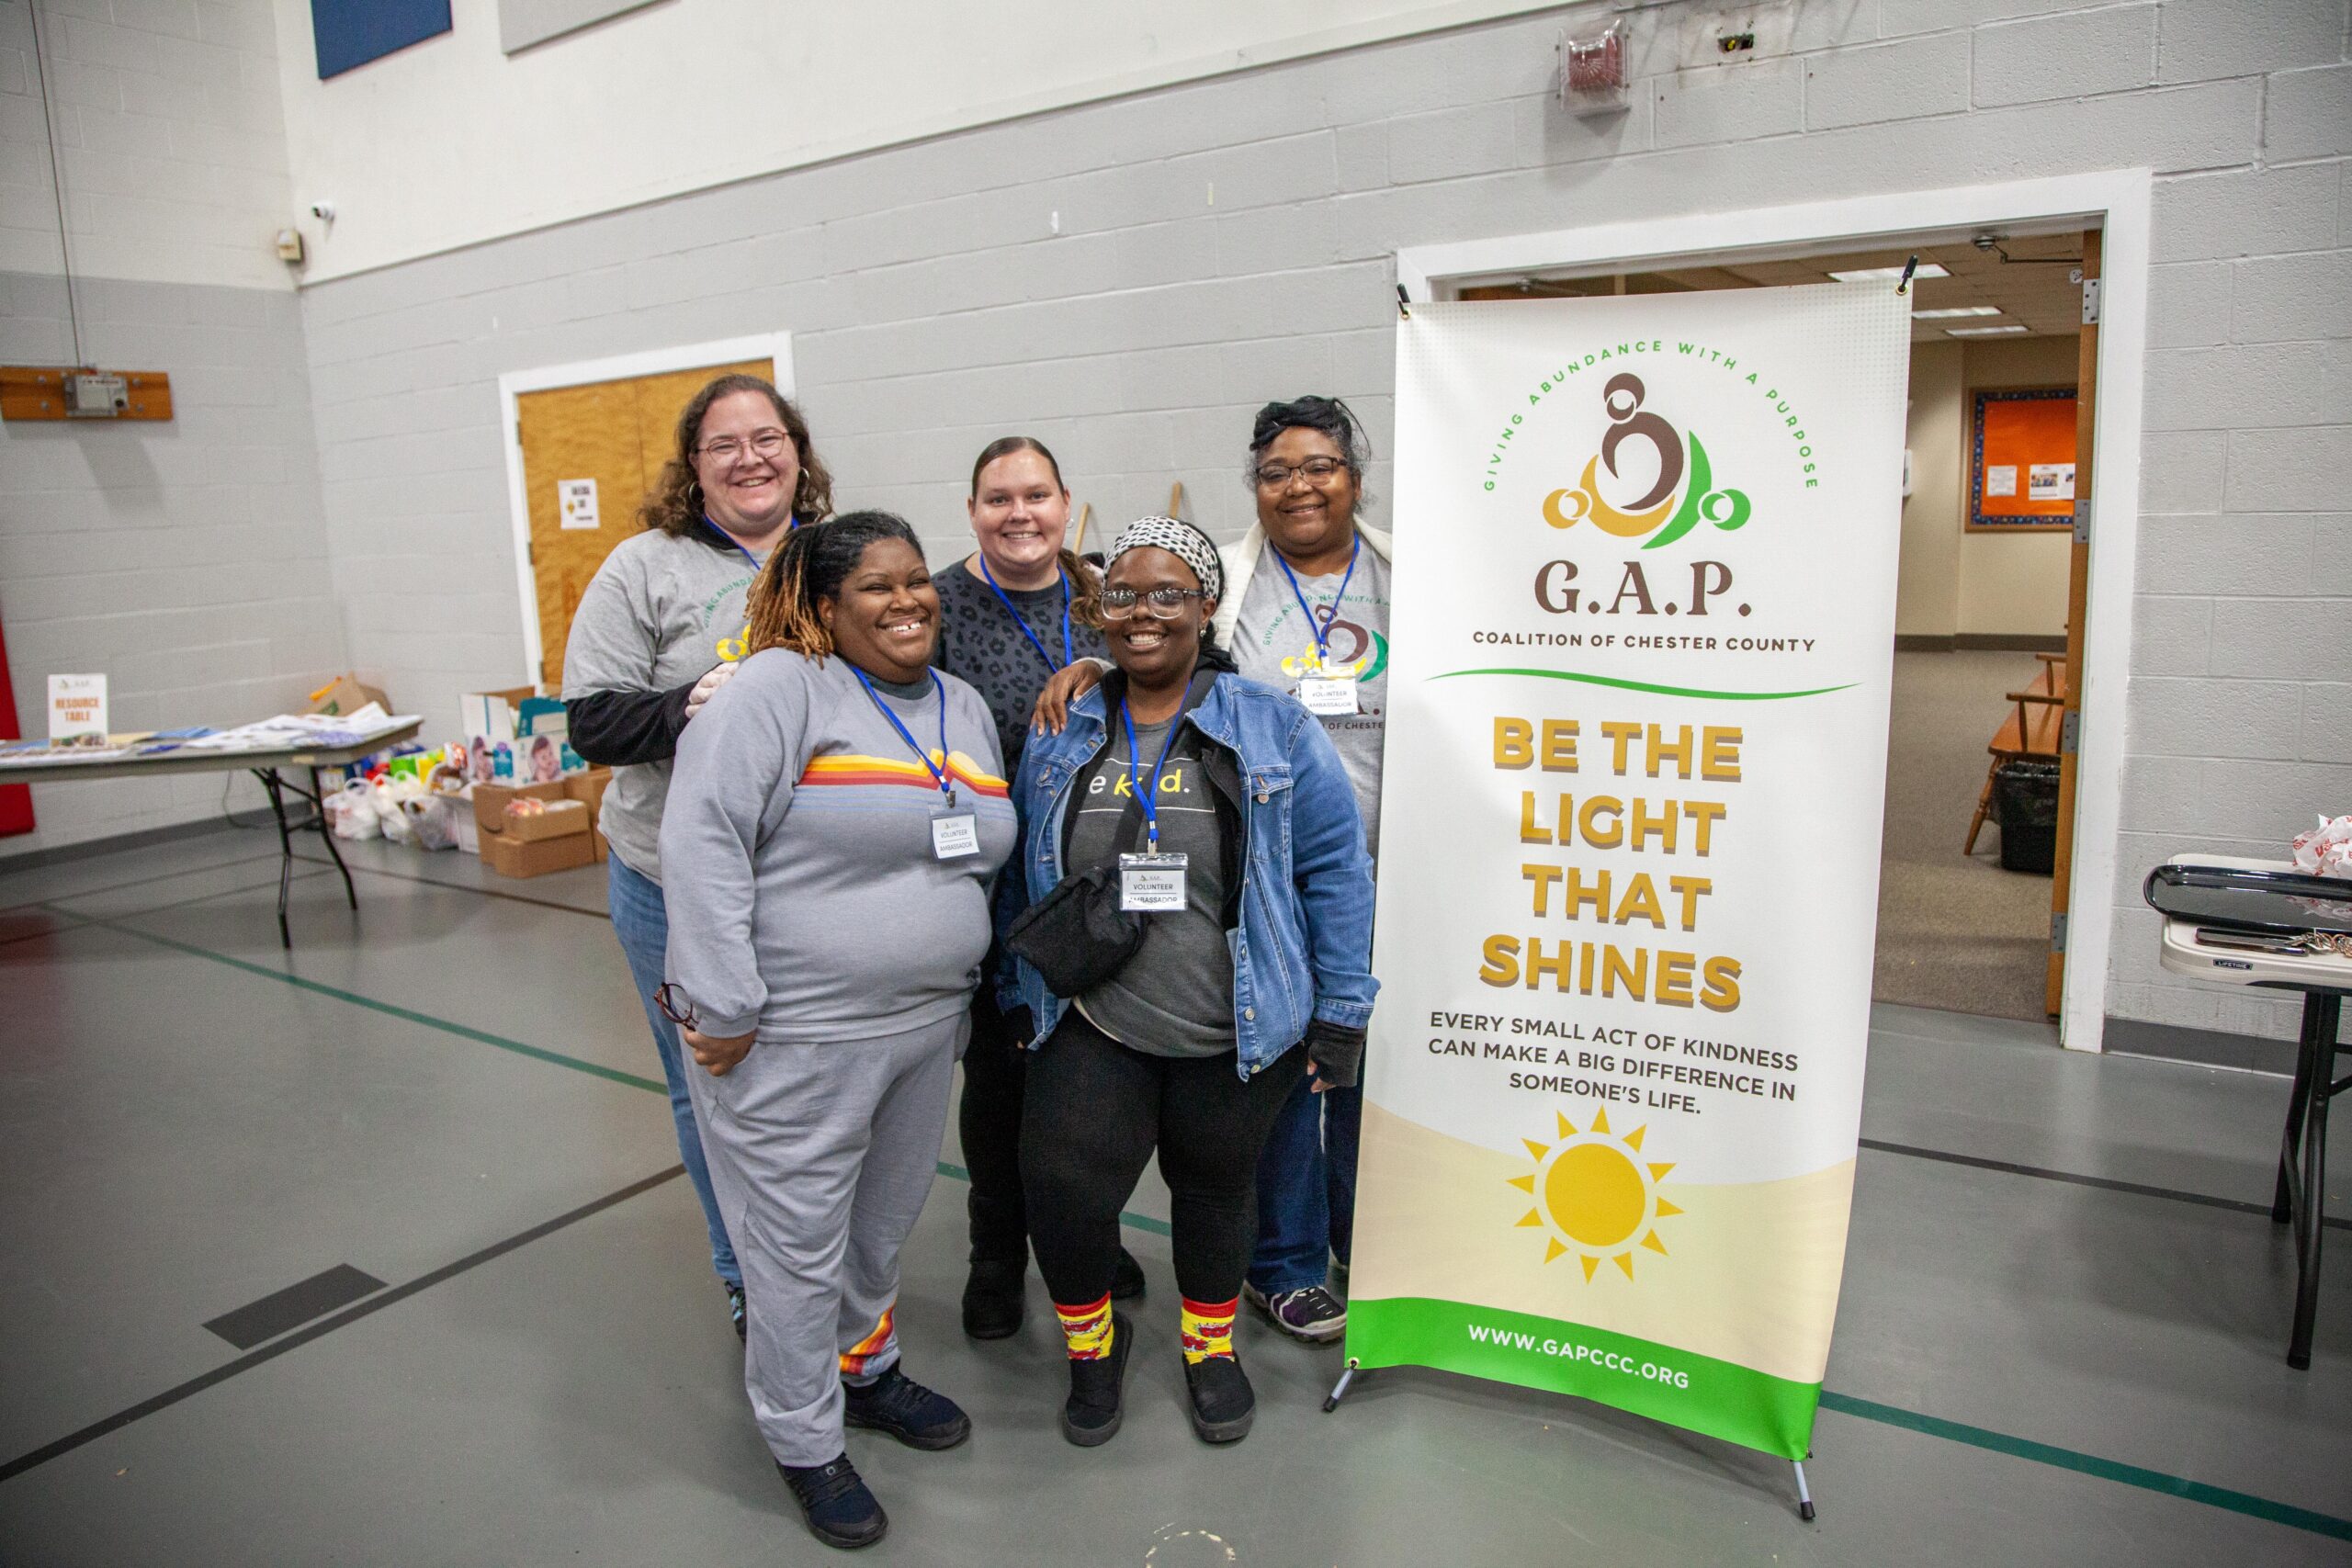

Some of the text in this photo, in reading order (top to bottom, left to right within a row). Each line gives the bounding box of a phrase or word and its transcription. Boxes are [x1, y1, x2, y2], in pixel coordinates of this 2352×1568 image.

[1484, 341, 1818, 491] GIVING ABUNDANCE WITH A PURPOSE
[717, 577, 752, 598] ABUNDA
[1533, 558, 1752, 616] G.A.P.
[1262, 616, 1283, 645] GIVING
[1472, 631, 1816, 652] COALITION OF CHESTER COUNTY
[56, 698, 98, 708] RESOURCE
[65, 712, 89, 721] TABLE
[1345, 721, 1385, 729] CHESTE
[1493, 716, 1744, 784] BE THE
[1089, 768, 1191, 798] e kd.
[940, 829, 968, 838] VOLUNTEER
[1519, 790, 1727, 857] LIGHT
[940, 840, 973, 852] AMBASSADOR
[1521, 863, 1713, 932] THAT
[1477, 933, 1744, 1014] SHINES
[2217, 961, 2248, 969] LIFETIME
[1430, 1011, 1798, 1072] EVERY SMALL ACT OF KINDNESS
[1429, 1038, 1795, 1101] CAN MAKE A BIG DIFFERENCE IN
[1510, 1072, 1702, 1114] SOMEONE'S LIFE.
[1468, 1324, 1690, 1389] WWW.GAPCCC.ORG
